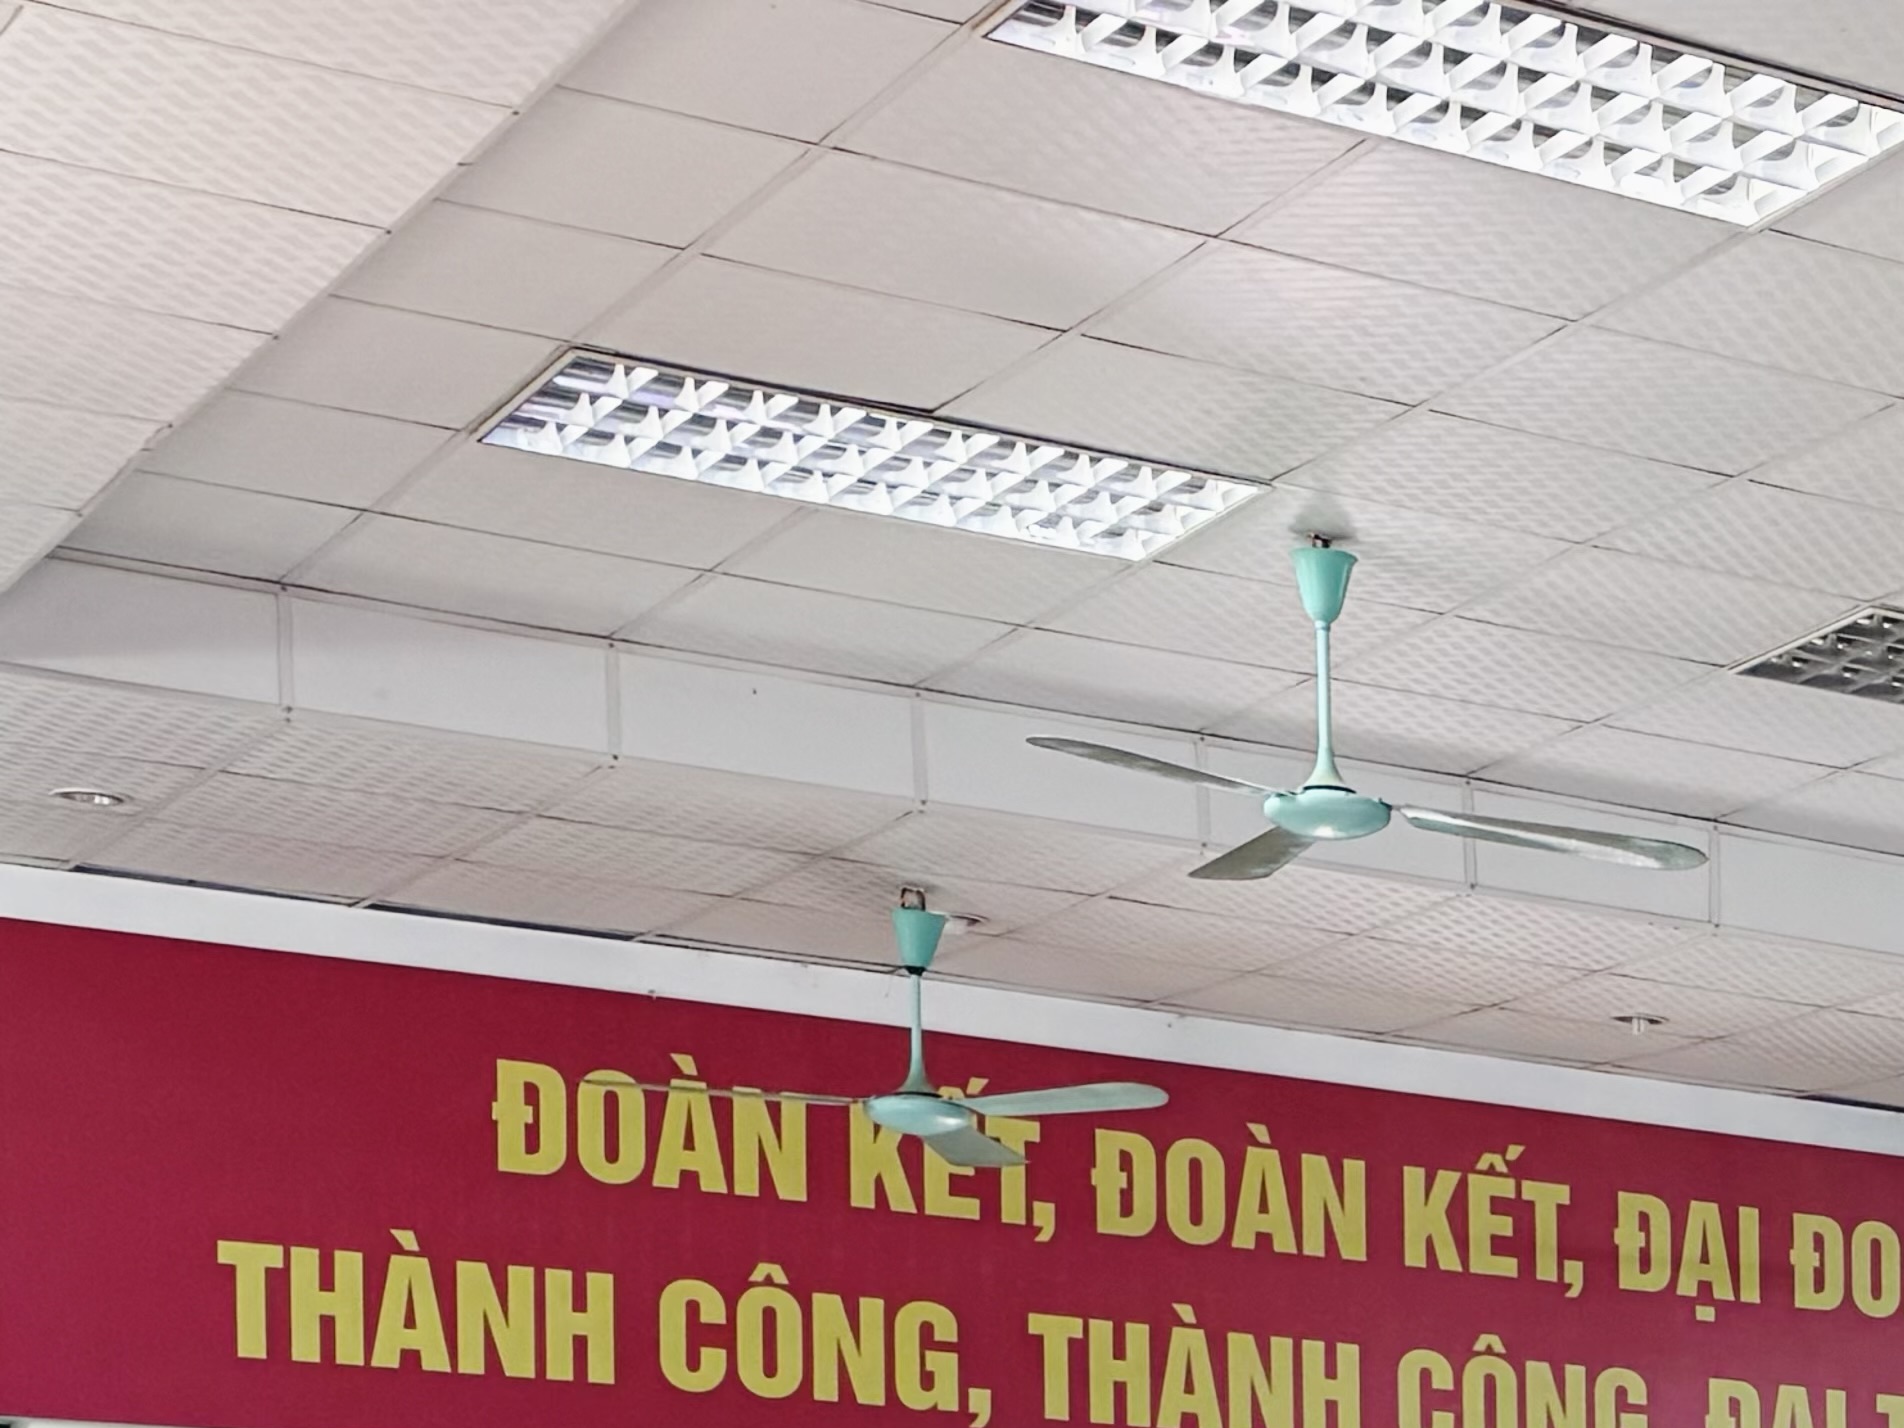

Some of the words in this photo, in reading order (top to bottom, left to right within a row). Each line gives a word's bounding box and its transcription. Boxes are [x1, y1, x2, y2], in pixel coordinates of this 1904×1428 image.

[491, 1053, 807, 1201] ĐOÀN
[1090, 1124, 1366, 1260] ĐOÀN
[1402, 1144, 1583, 1296] KẾT,
[1613, 1192, 1759, 1320] ĐẠI
[216, 1230, 615, 1384] THÀNH
[658, 1262, 990, 1427] CÔNG,
